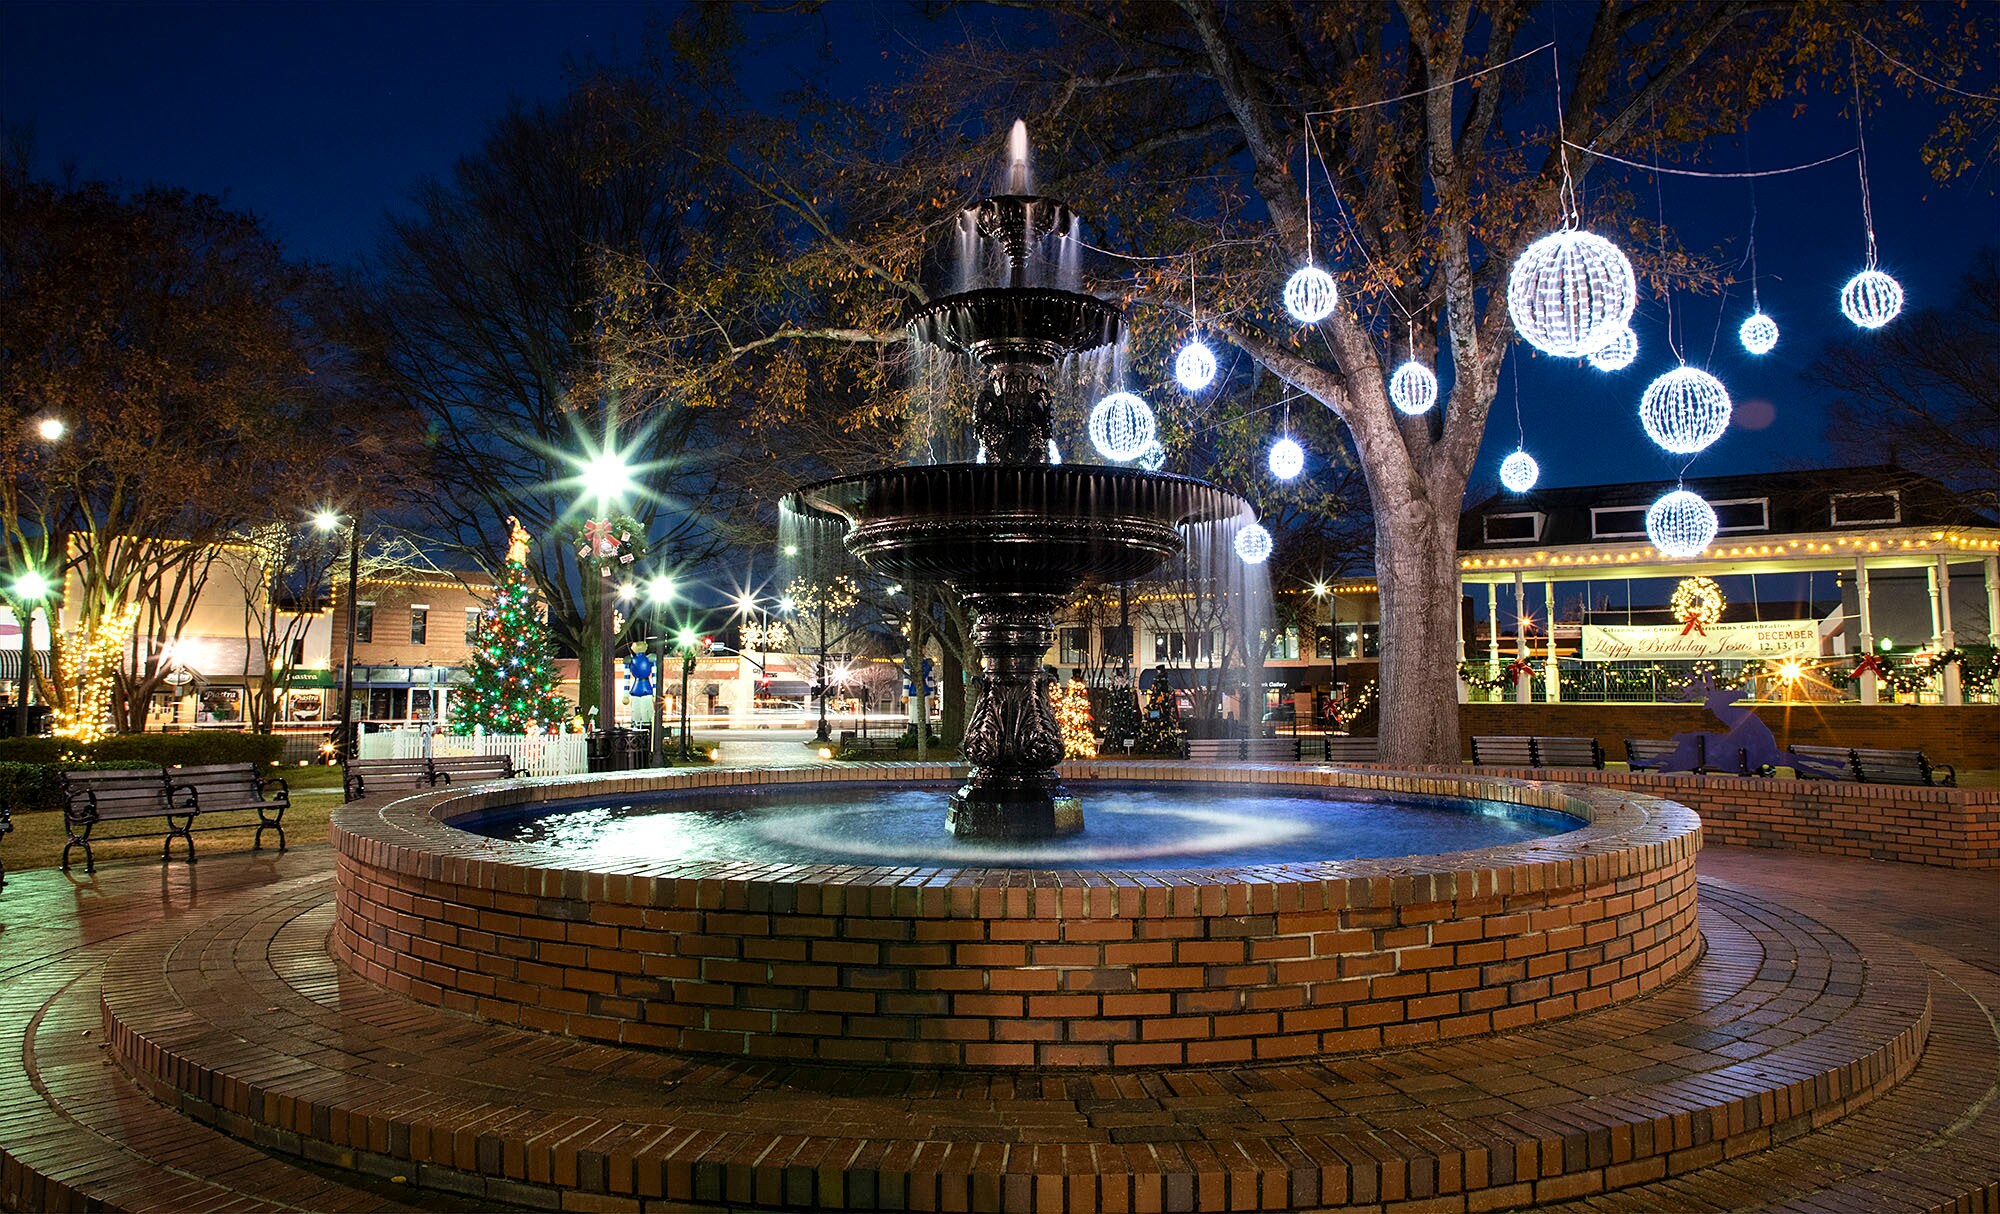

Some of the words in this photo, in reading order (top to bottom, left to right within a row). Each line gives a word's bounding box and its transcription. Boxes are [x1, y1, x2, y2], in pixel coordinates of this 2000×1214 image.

[1693, 624, 1737, 632] Cristmas
[1740, 623, 1791, 631] Celebration
[1757, 630, 1814, 641] DECEMBER
[1585, 638, 1633, 658] Happy
[1638, 637, 1707, 658] Birthday
[1707, 635, 1753, 655] Jesus
[1759, 642, 1774, 651] 12,
[1777, 641, 1791, 650] 13,
[1794, 641, 1805, 650] 14
[1268, 681, 1288, 689] Gallery
